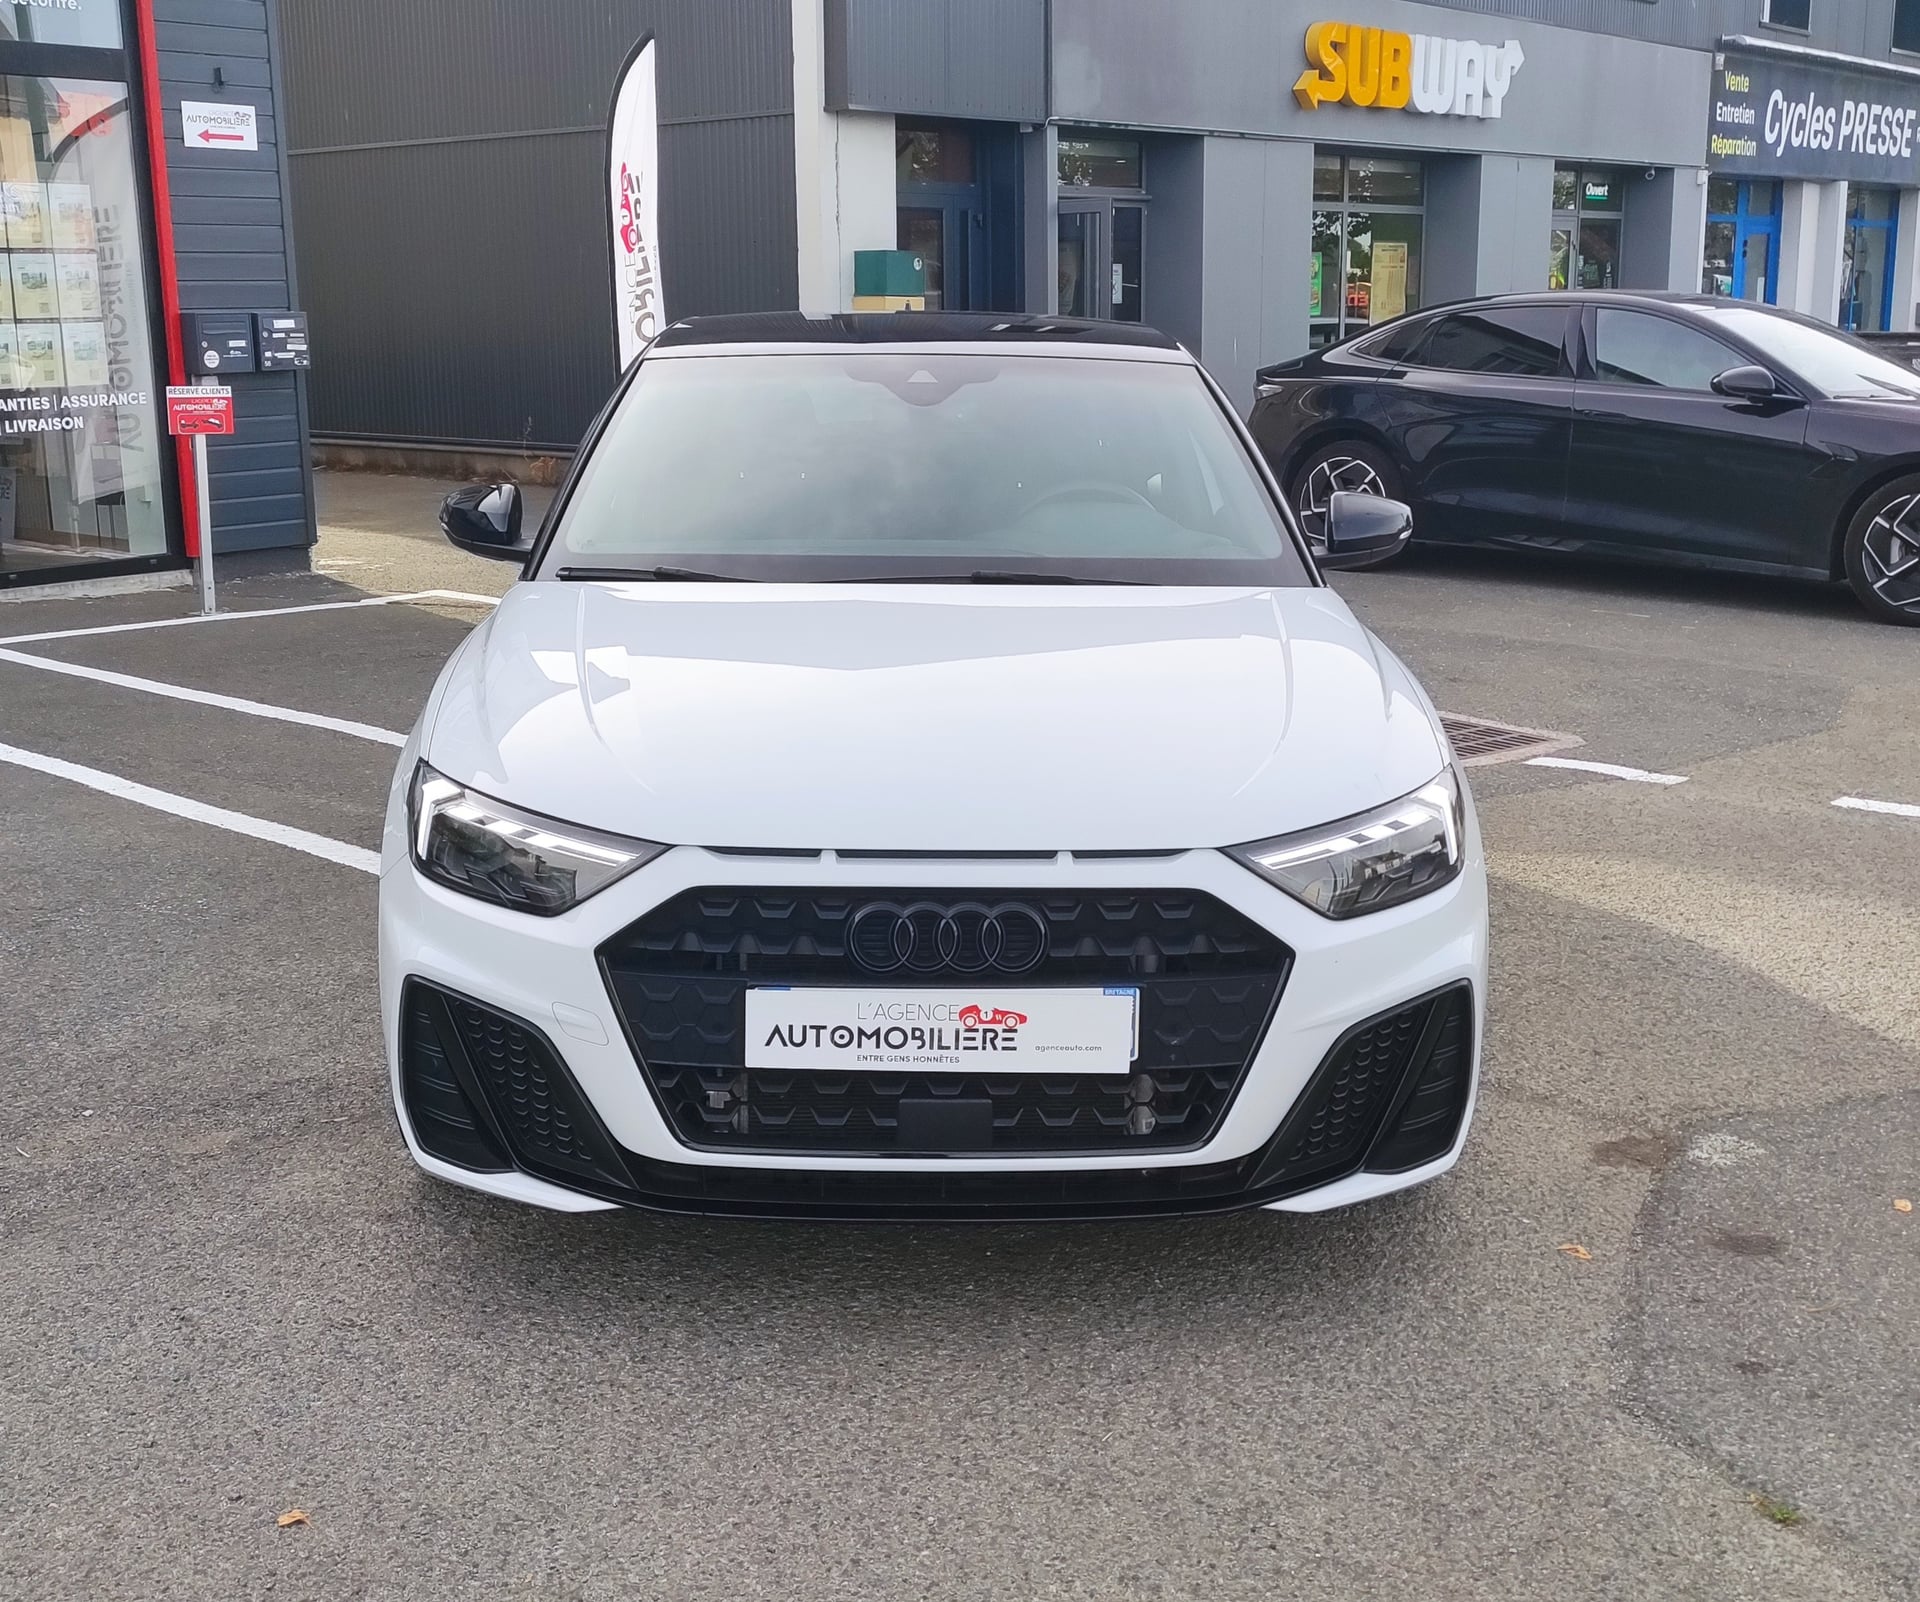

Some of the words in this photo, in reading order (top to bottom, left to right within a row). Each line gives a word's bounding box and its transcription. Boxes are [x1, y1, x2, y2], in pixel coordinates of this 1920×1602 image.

[1293, 20, 1525, 119] SUBWAY
[1725, 70, 1750, 93] Vente
[1716, 101, 1755, 125] Entretien
[1764, 88, 1836, 158] Cycles
[1837, 99, 1916, 158] PRESSE
[1711, 134, 1757, 159] Réparation
[1586, 182, 1608, 196] Ouvert
[60, 392, 148, 409] ASSURANCE
[200, 387, 230, 395] CLIENTS
[5, 416, 84, 434] LIVRAISON
[857, 1002, 960, 1021] L'AGENCE
[764, 1023, 1018, 1051] AUTOMOBILIERE
[1034, 1045, 1103, 1053] agenceauto.com
[856, 1054, 885, 1063] ENTRE
[886, 1055, 911, 1064] GENS
[912, 1054, 961, 1064] HONNÊTES
